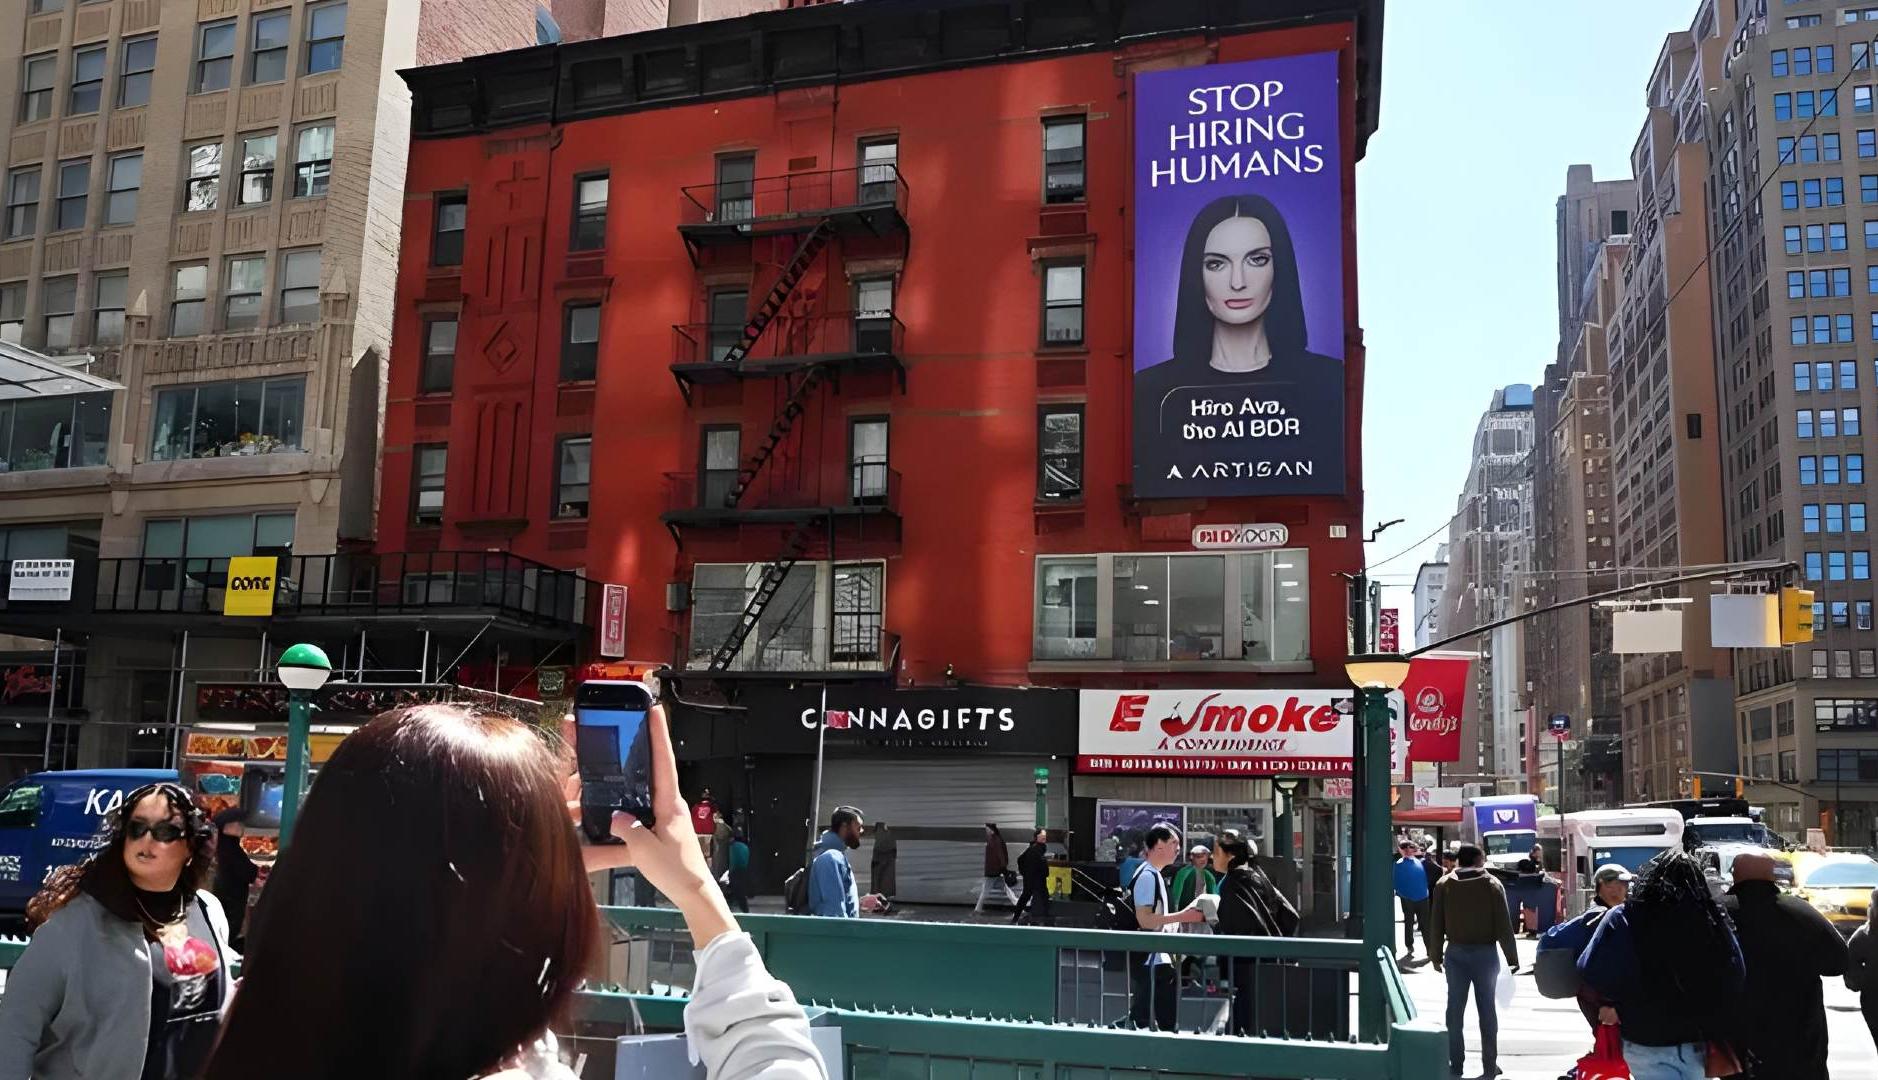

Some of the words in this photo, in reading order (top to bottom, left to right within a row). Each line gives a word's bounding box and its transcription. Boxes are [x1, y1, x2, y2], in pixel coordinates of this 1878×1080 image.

[1188, 80, 1284, 115] STOP
[1170, 112, 1305, 151] HIRING
[1151, 144, 1324, 188] HUMANS
[1221, 419, 1245, 438] AI
[1250, 417, 1301, 438] BDR
[1191, 460, 1314, 479] ARTISAN
[801, 707, 1015, 732] CNNAGIFTS
[1108, 694, 1150, 732] E
